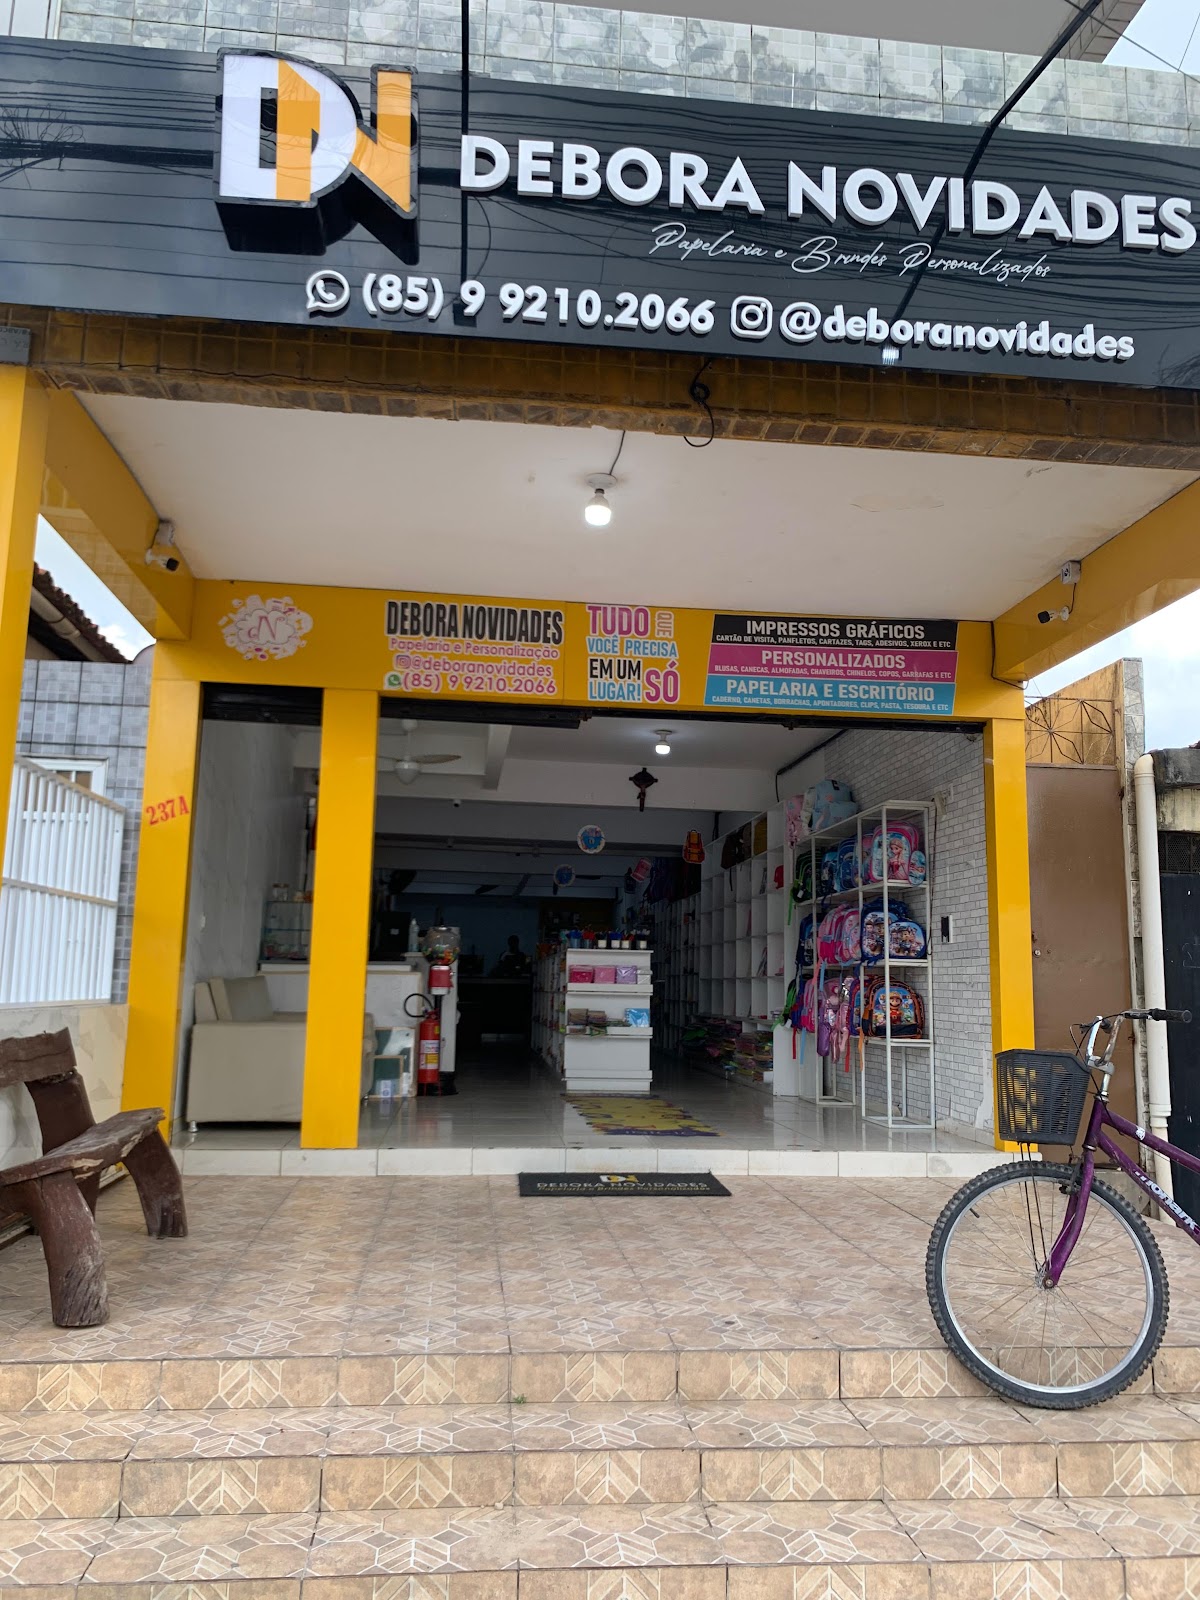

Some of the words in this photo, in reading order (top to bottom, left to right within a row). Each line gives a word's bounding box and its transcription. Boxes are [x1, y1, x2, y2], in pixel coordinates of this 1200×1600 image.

[459, 134, 765, 214] DEBORA
[787, 159, 1197, 254] NOVIDADES
[648, 221, 769, 261] Papelaria
[774, 249, 787, 258] e
[791, 236, 887, 274] Brindes
[898, 242, 1051, 283] Personalizados
[363, 273, 444, 321] (85)
[459, 280, 486, 316] 9
[499, 282, 715, 336] 9210.2066
[779, 301, 1135, 361] @deboranovidades
[387, 601, 458, 638] DEBORA
[463, 605, 563, 645] NOVIDADES
[587, 605, 650, 636] TUDO
[655, 611, 674, 638] QUE
[746, 620, 840, 637] IMPRESSOS
[846, 621, 925, 639] GRÁFICOS
[390, 638, 450, 652] Papelaria
[454, 643, 461, 652] e
[465, 643, 559, 660] Personalização
[586, 635, 620, 654] VOCÊ
[624, 638, 678, 658] PRECISA
[716, 634, 742, 642] CARTÃO
[754, 636, 777, 644] VISITA,
[778, 637, 817, 645] PANFLETOS,
[819, 638, 854, 646] CARTAZES,
[855, 639, 873, 647] TAGS,
[412, 656, 552, 677] @deboranovidades
[589, 659, 613, 679] EM
[616, 659, 641, 680] UM
[761, 650, 906, 669] PERSONALIZADOS
[403, 672, 441, 692] (85)
[449, 675, 458, 689] 9
[464, 676, 556, 694] 9210.2066
[645, 661, 680, 703] SÓ
[714, 665, 739, 673] BLUSAS,
[740, 666, 770, 674] CANECAS,
[771, 667, 809, 675] ALMOFADAS,
[810, 668, 845, 676] CHAVEIROS,
[902, 671, 934, 679] GARRAFAS
[588, 682, 641, 702] LUGAR!
[726, 679, 818, 697] PAPELARIA
[823, 683, 833, 698] E
[838, 682, 934, 701] ESCRITÓRIO
[743, 697, 773, 705] CANETAS,
[774, 698, 812, 706] BORRACHAS,
[813, 700, 859, 708] APONTADORES,
[881, 702, 901, 710] PASTA,
